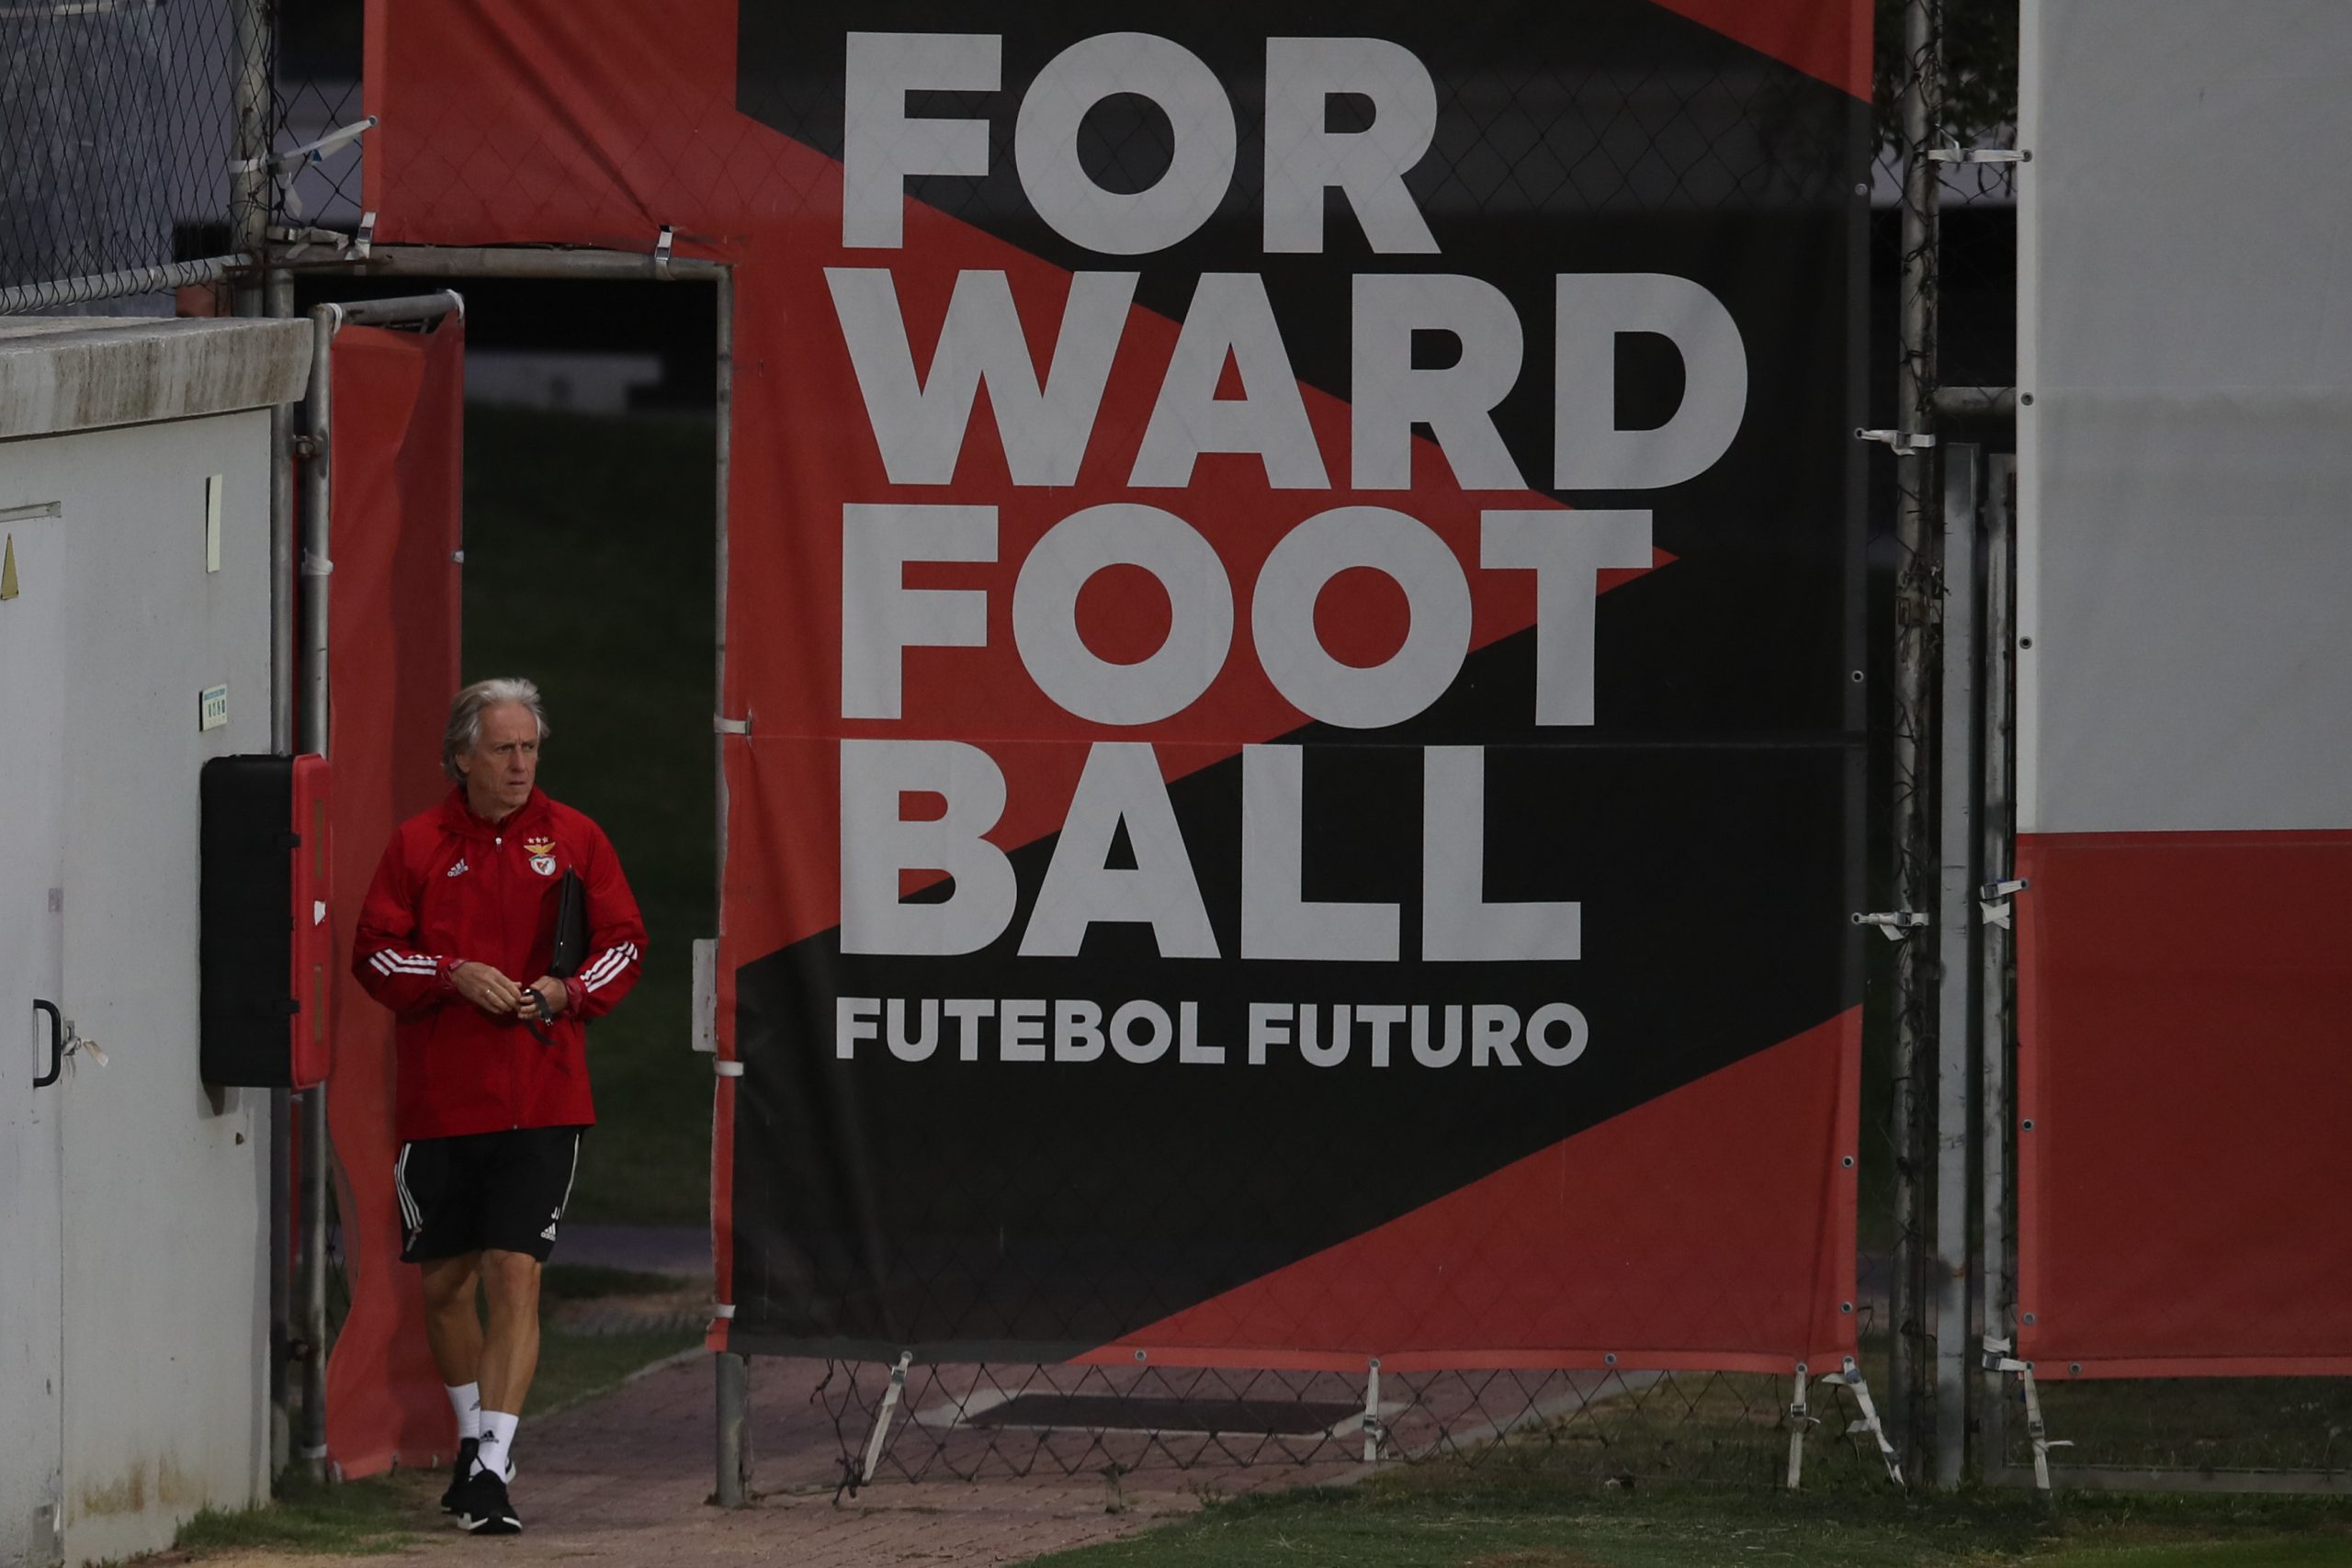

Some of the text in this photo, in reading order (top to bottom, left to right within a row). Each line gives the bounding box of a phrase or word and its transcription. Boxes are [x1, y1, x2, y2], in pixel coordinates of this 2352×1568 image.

[842, 32, 1441, 254] FOR
[823, 267, 1747, 490] WARD
[841, 503, 1653, 728] FOOT
[840, 739, 1581, 961] BALL
[836, 998, 1589, 1067] FUTEBOL FUTURO
